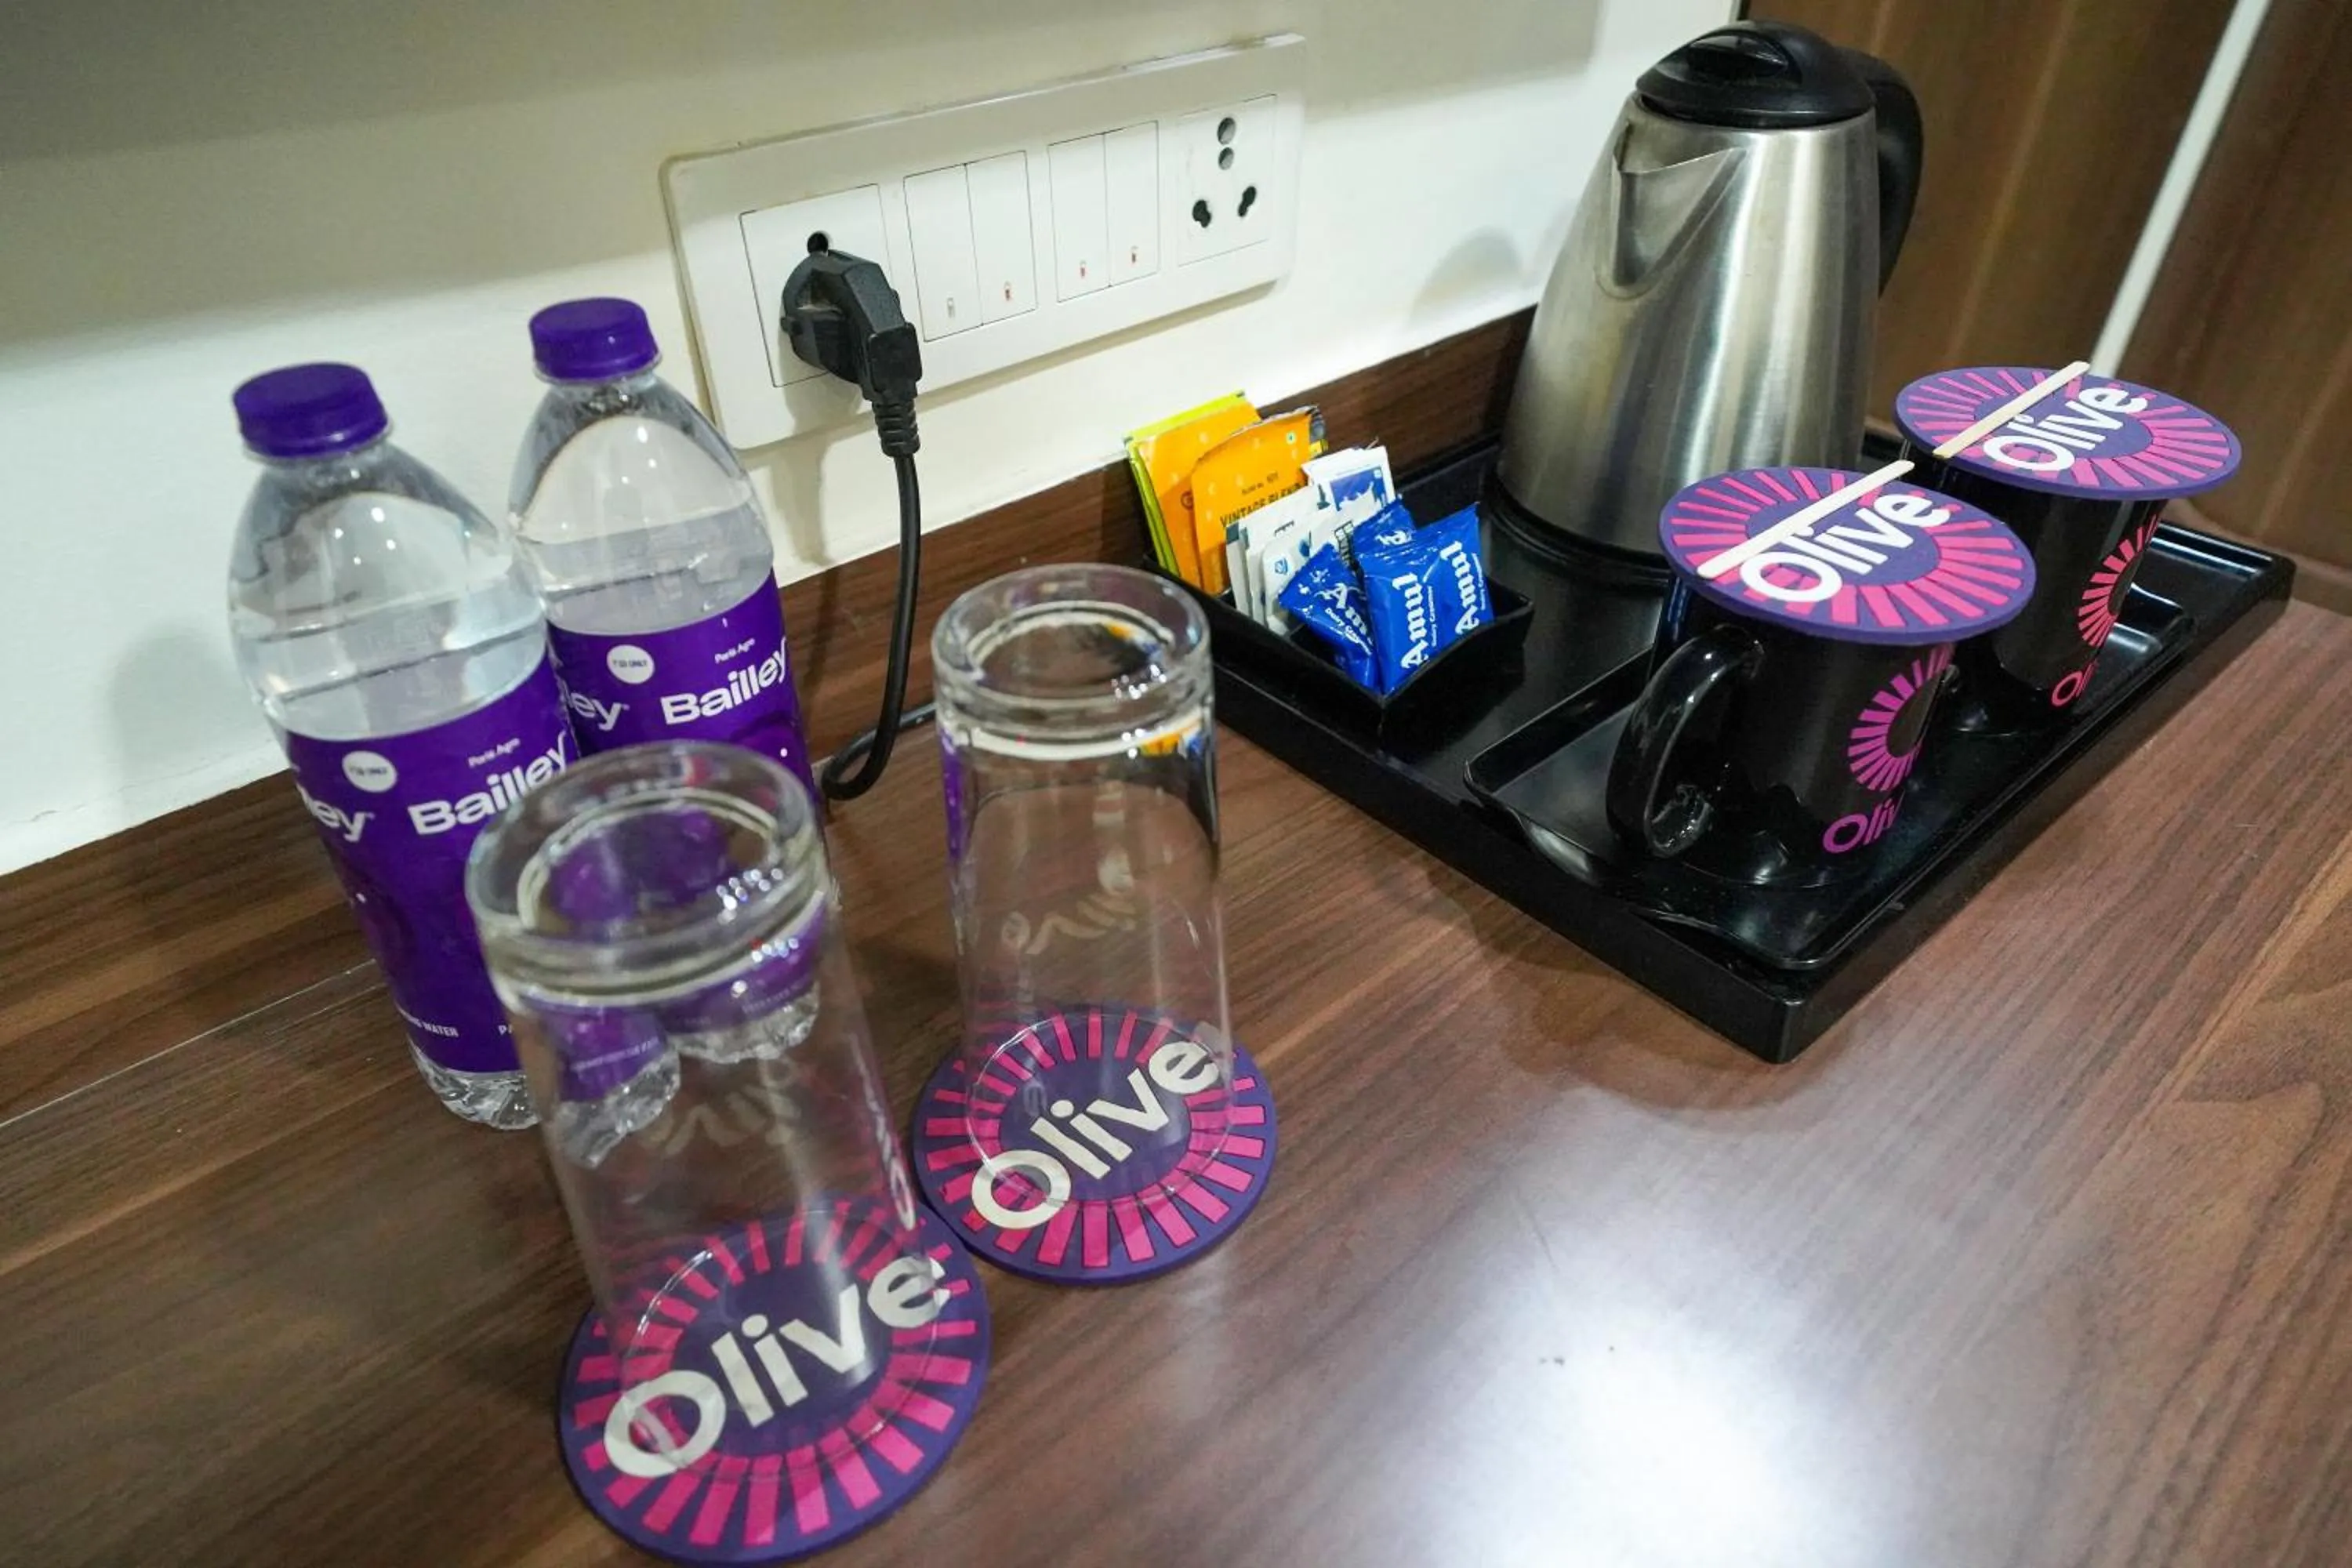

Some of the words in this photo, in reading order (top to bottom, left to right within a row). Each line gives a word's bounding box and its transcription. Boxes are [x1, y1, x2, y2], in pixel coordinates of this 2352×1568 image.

[1982, 387, 2148, 471] Olive
[1439, 540, 1480, 634] Amul
[1739, 494, 1951, 602] Olive
[1392, 572, 1429, 669] Amul
[570, 692, 623, 731] ey
[660, 636, 786, 725] Bailley
[407, 730, 567, 835] Bailley
[971, 1040, 1220, 1229] Olive
[603, 1254, 951, 1478] Olive
